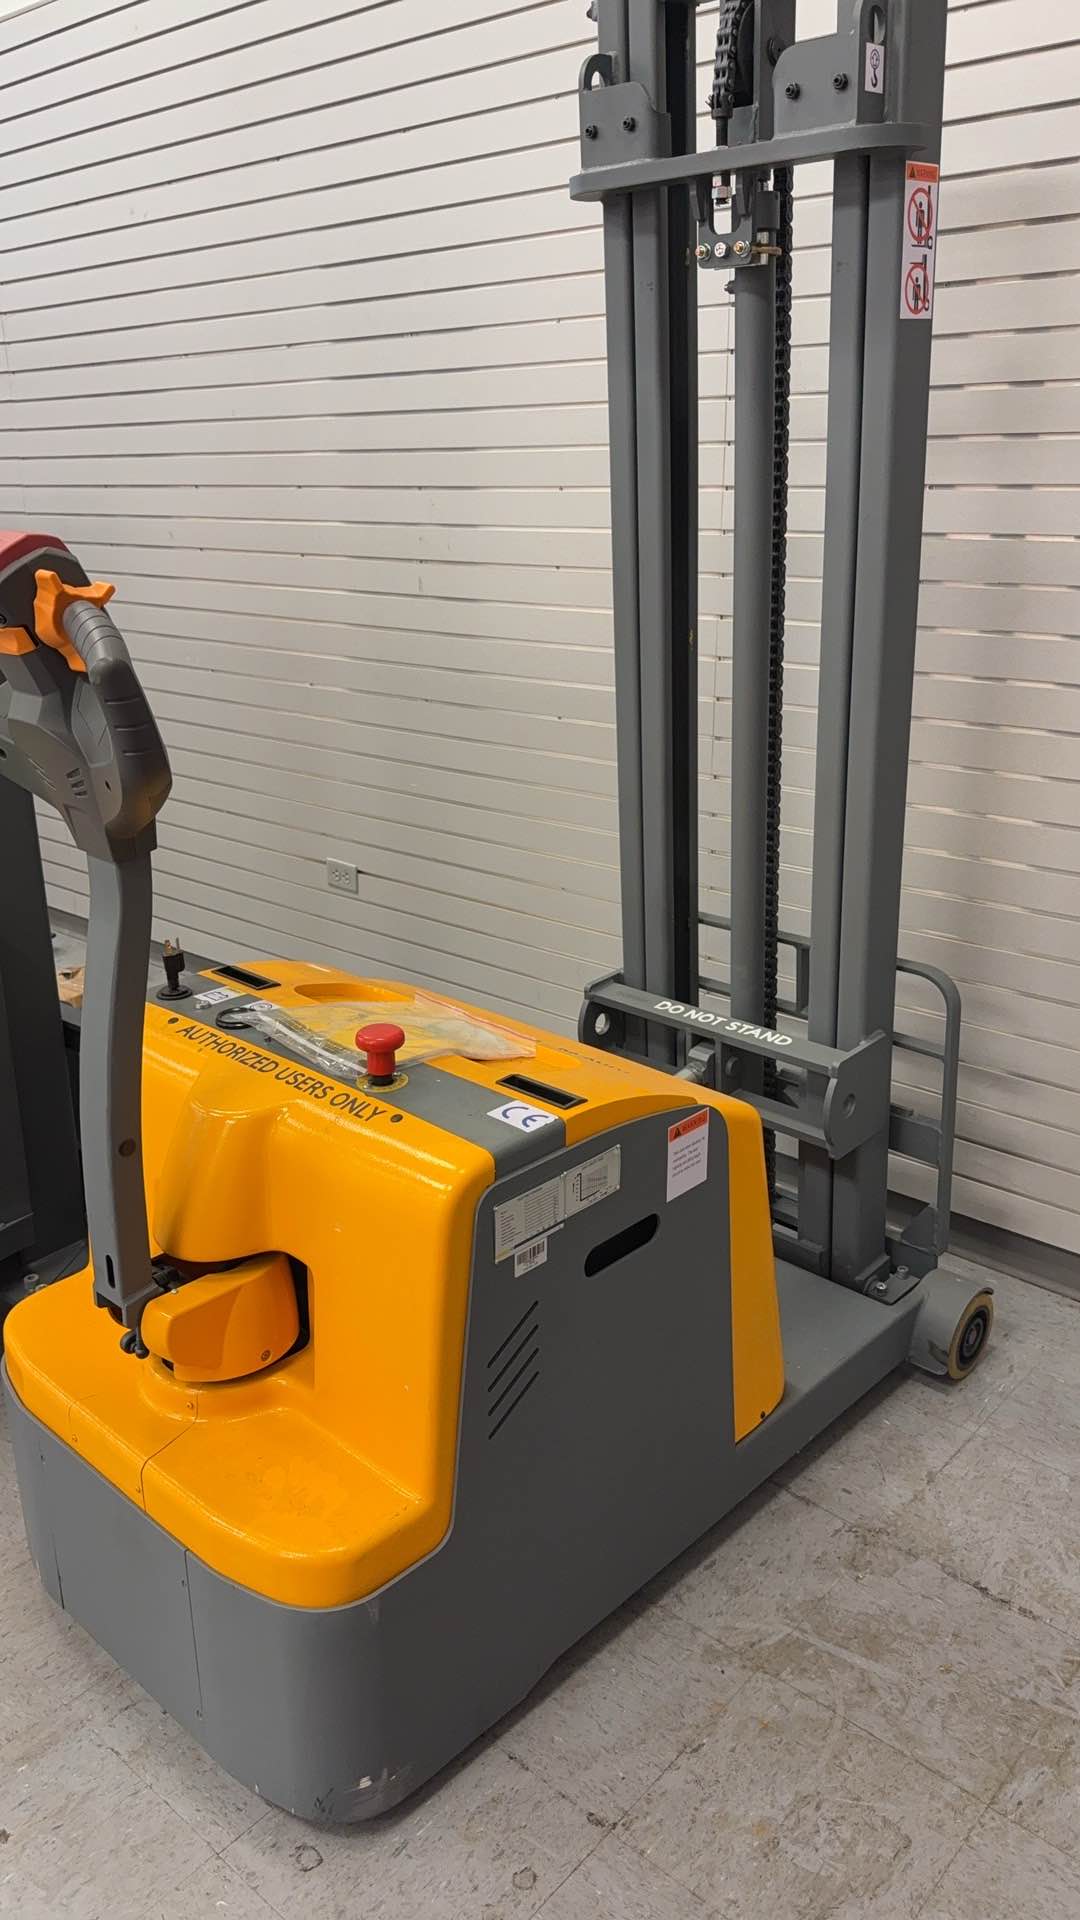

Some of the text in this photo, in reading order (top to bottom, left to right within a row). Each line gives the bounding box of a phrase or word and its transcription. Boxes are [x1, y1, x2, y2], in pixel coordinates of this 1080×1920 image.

[654, 1000, 793, 1046] DO NOT STAND
[178, 1025, 279, 1073] AUTHORIZED
[275, 1067, 330, 1100] USERS
[330, 1093, 387, 1123] ONLY
[501, 1106, 549, 1128] CE
